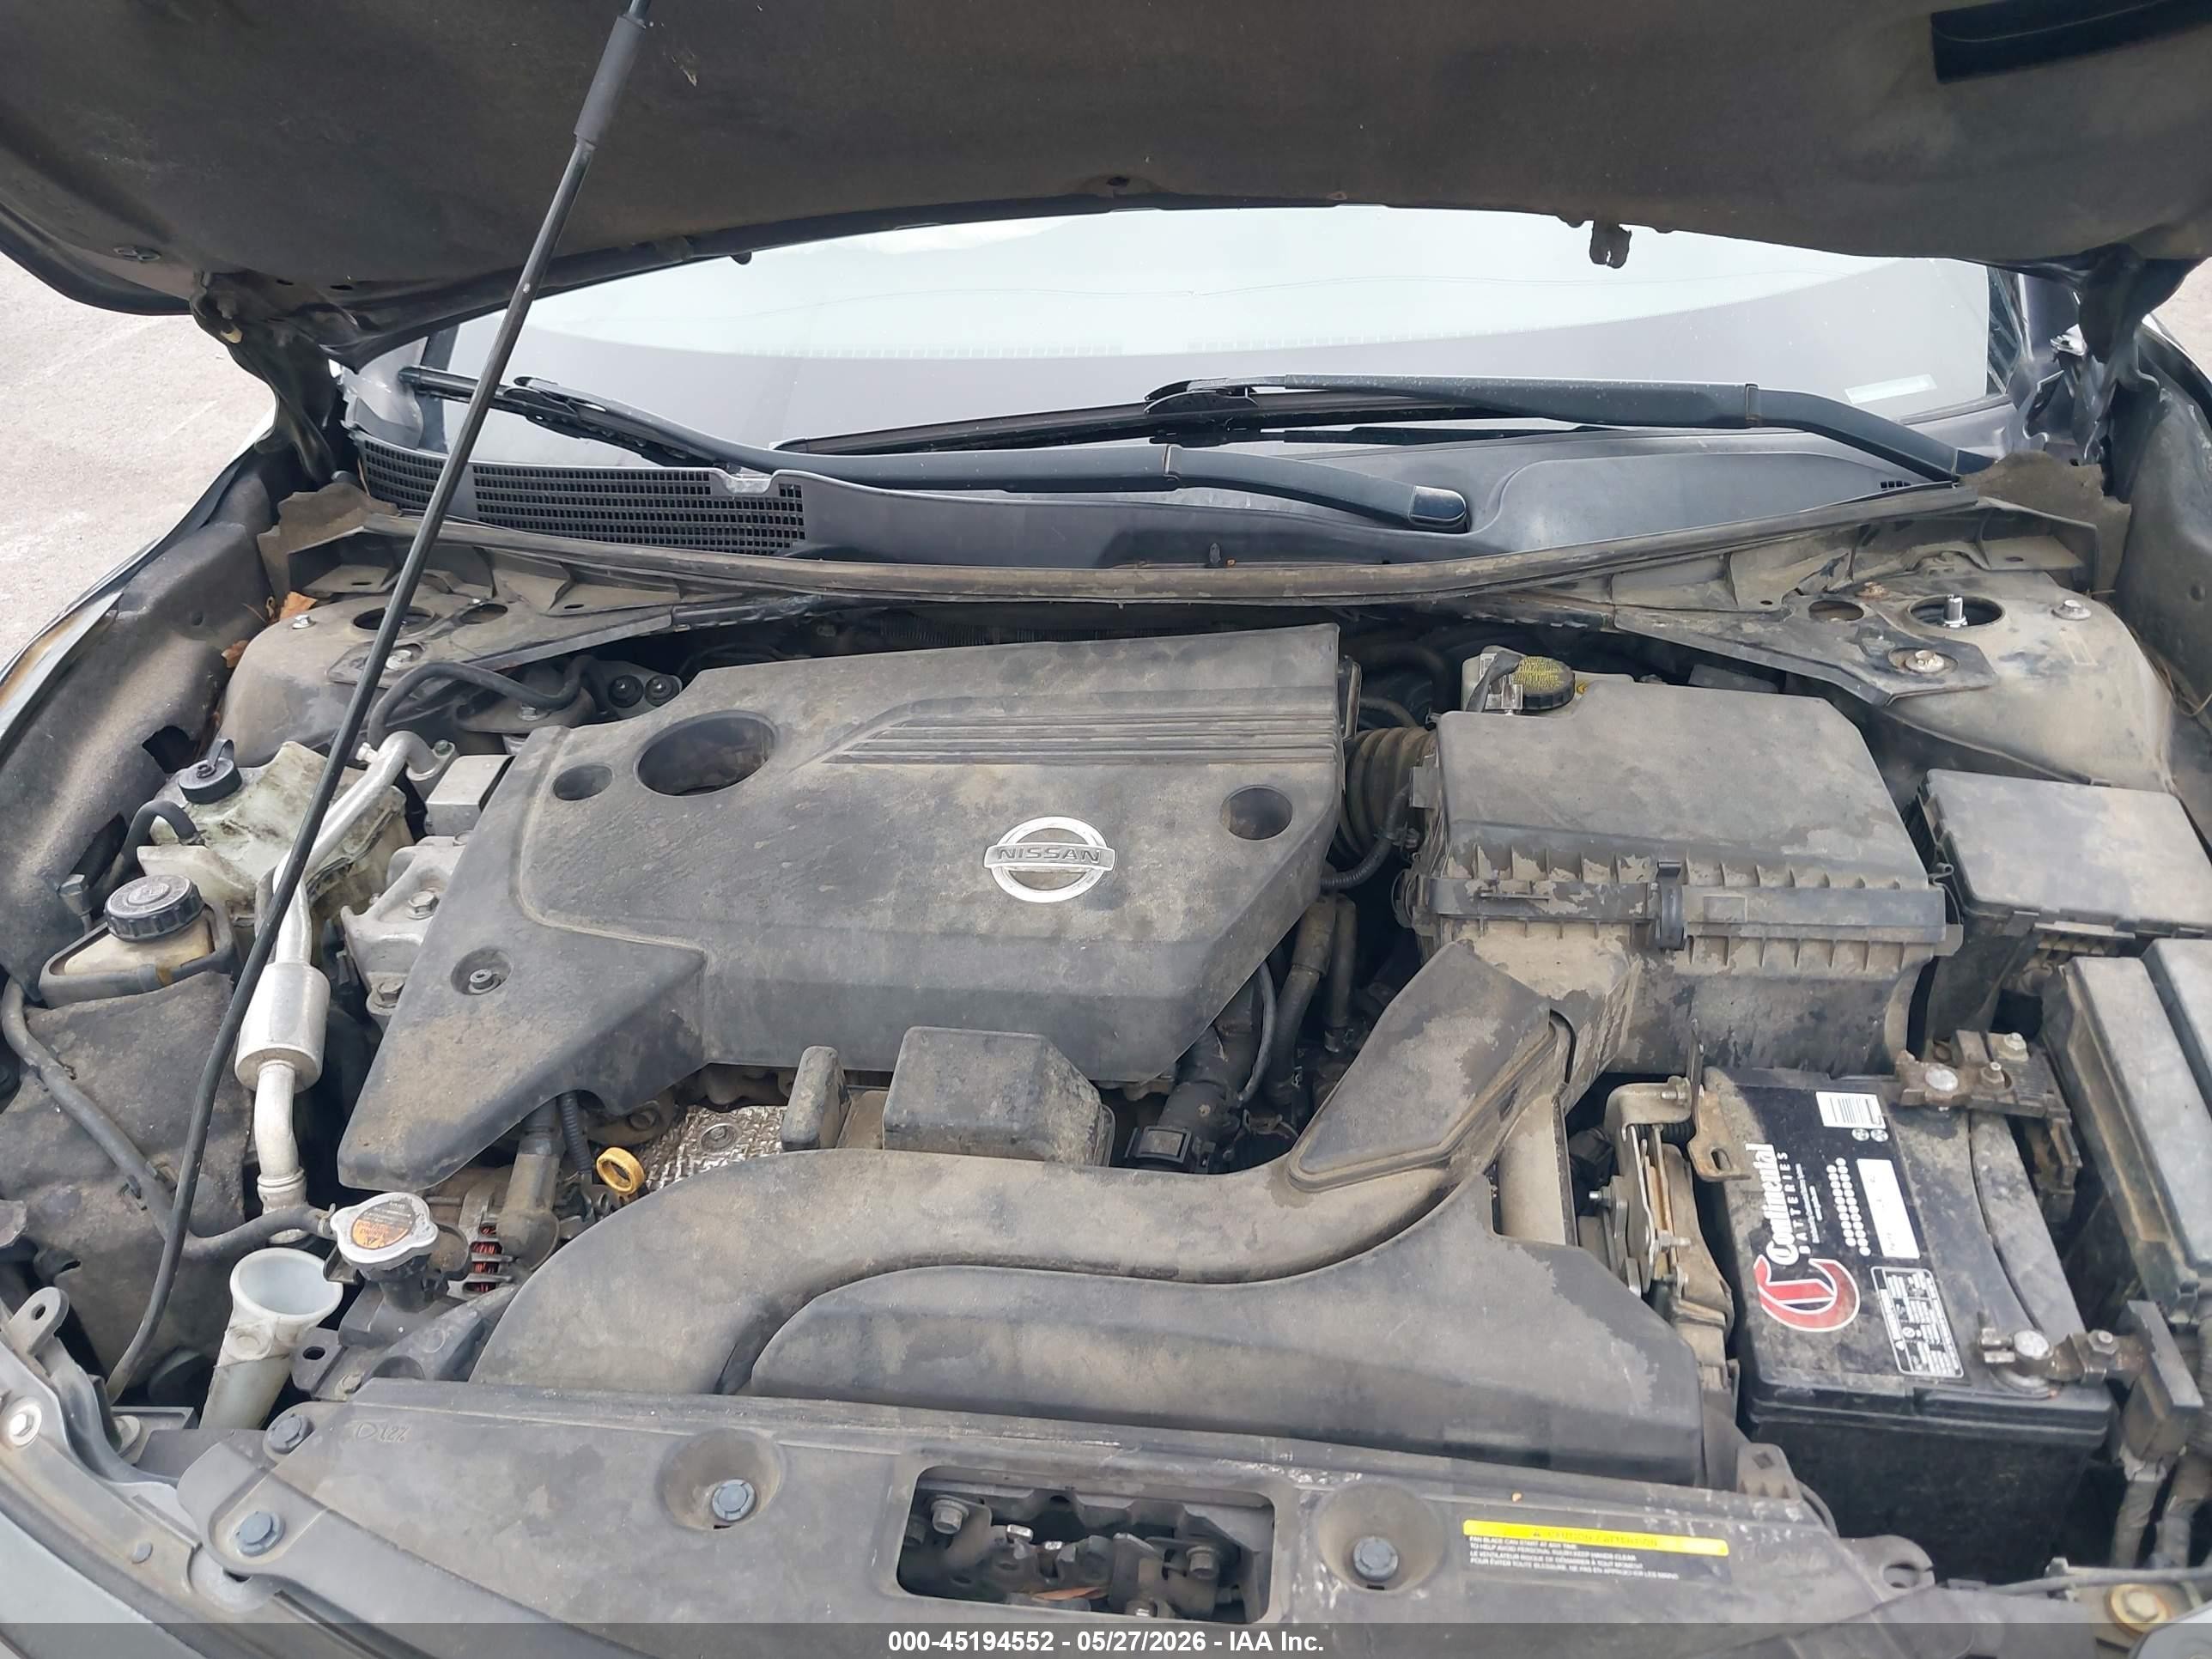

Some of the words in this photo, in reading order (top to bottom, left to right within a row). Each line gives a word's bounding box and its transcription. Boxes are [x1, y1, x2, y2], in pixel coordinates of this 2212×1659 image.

[998, 848, 1100, 864] NISSAN
[1745, 1143, 1799, 1266] Continental
[1777, 1152, 1811, 1255] BATTERIES
